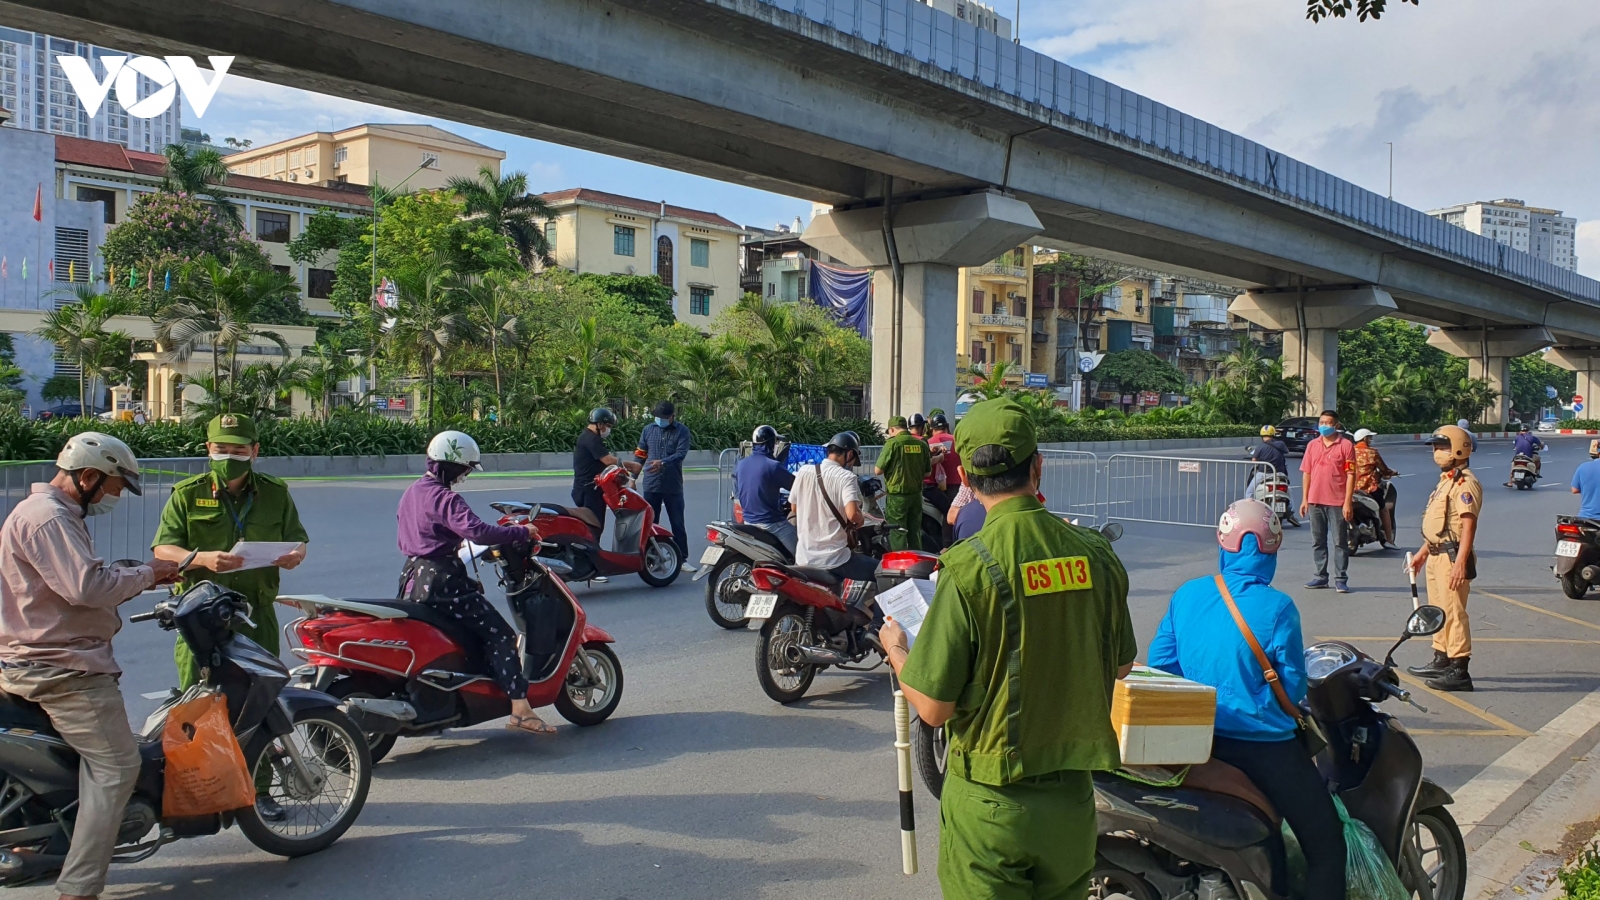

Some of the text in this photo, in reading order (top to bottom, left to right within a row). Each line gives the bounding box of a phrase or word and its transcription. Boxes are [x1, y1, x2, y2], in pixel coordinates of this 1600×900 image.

[1026, 559, 1087, 590] CS 113
[749, 606, 770, 616] 8465
[357, 637, 408, 646] LEAD
